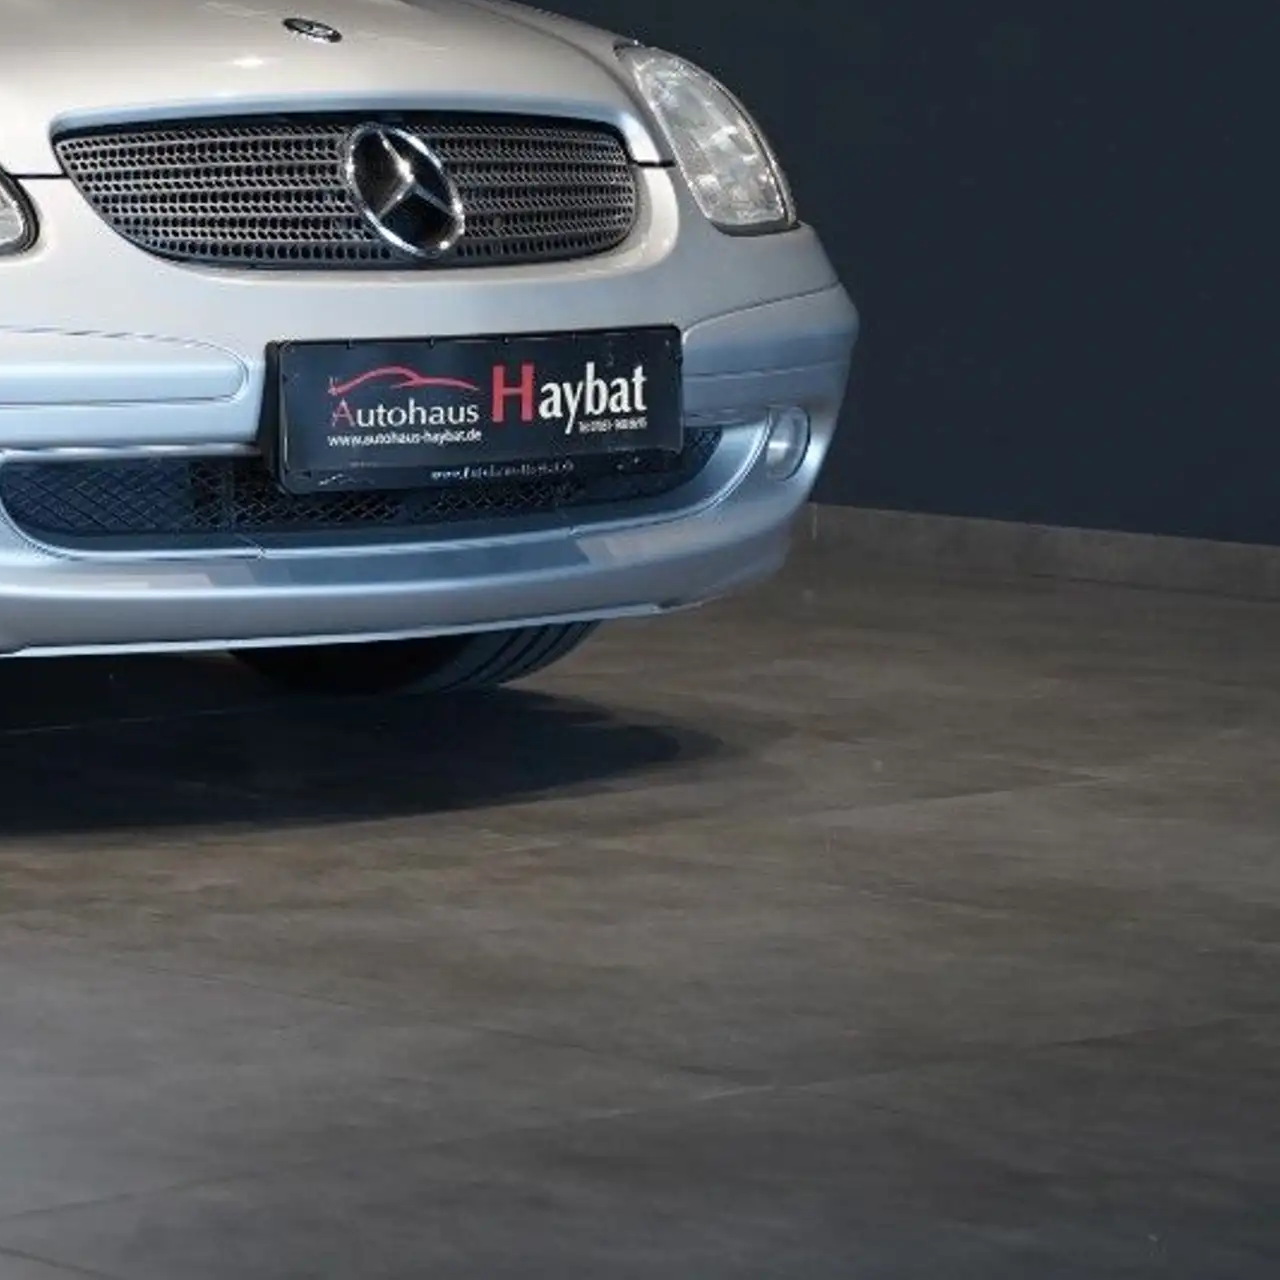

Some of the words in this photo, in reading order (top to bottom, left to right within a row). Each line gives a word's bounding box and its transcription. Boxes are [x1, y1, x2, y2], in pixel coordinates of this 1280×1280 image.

[332, 397, 480, 427] Autohaus
[492, 361, 647, 435] Haybat
[327, 428, 482, 447] www.autohaus-haybat.de
